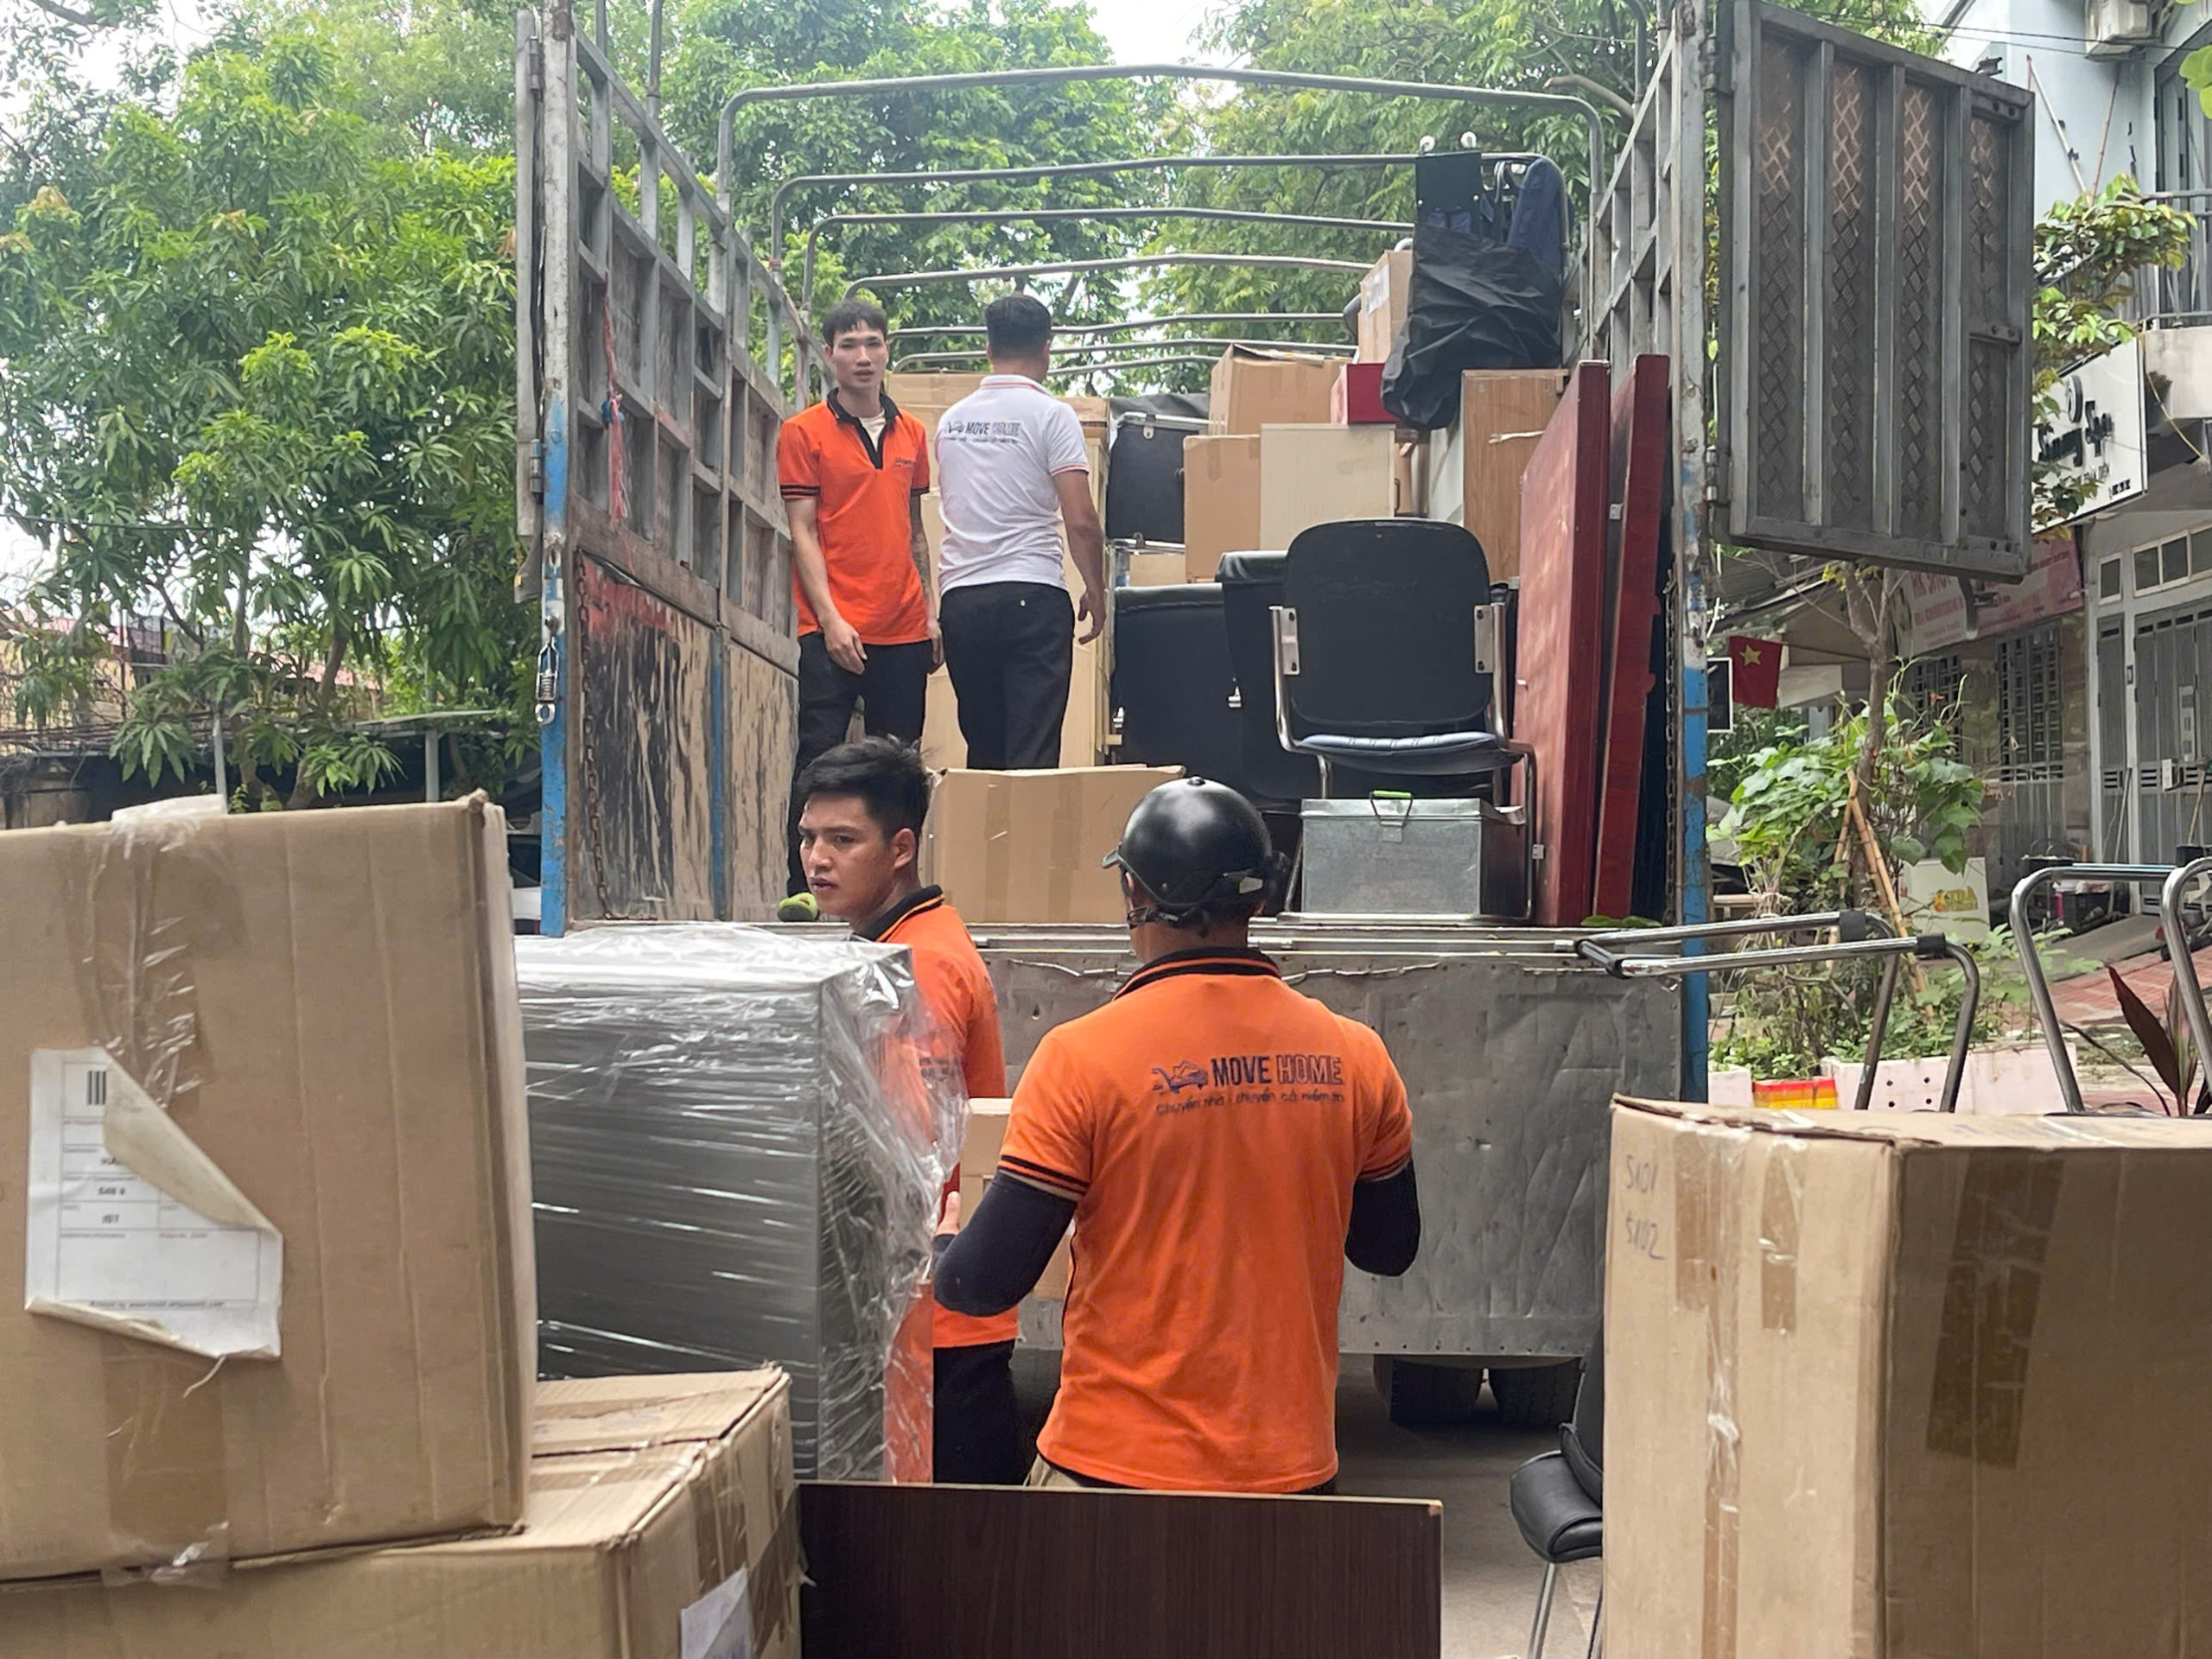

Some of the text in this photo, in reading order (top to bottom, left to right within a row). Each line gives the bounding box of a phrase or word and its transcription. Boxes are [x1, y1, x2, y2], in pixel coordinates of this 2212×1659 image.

[965, 422, 991, 435] MOVE
[1211, 1054, 1344, 1087] MOVE HOME
